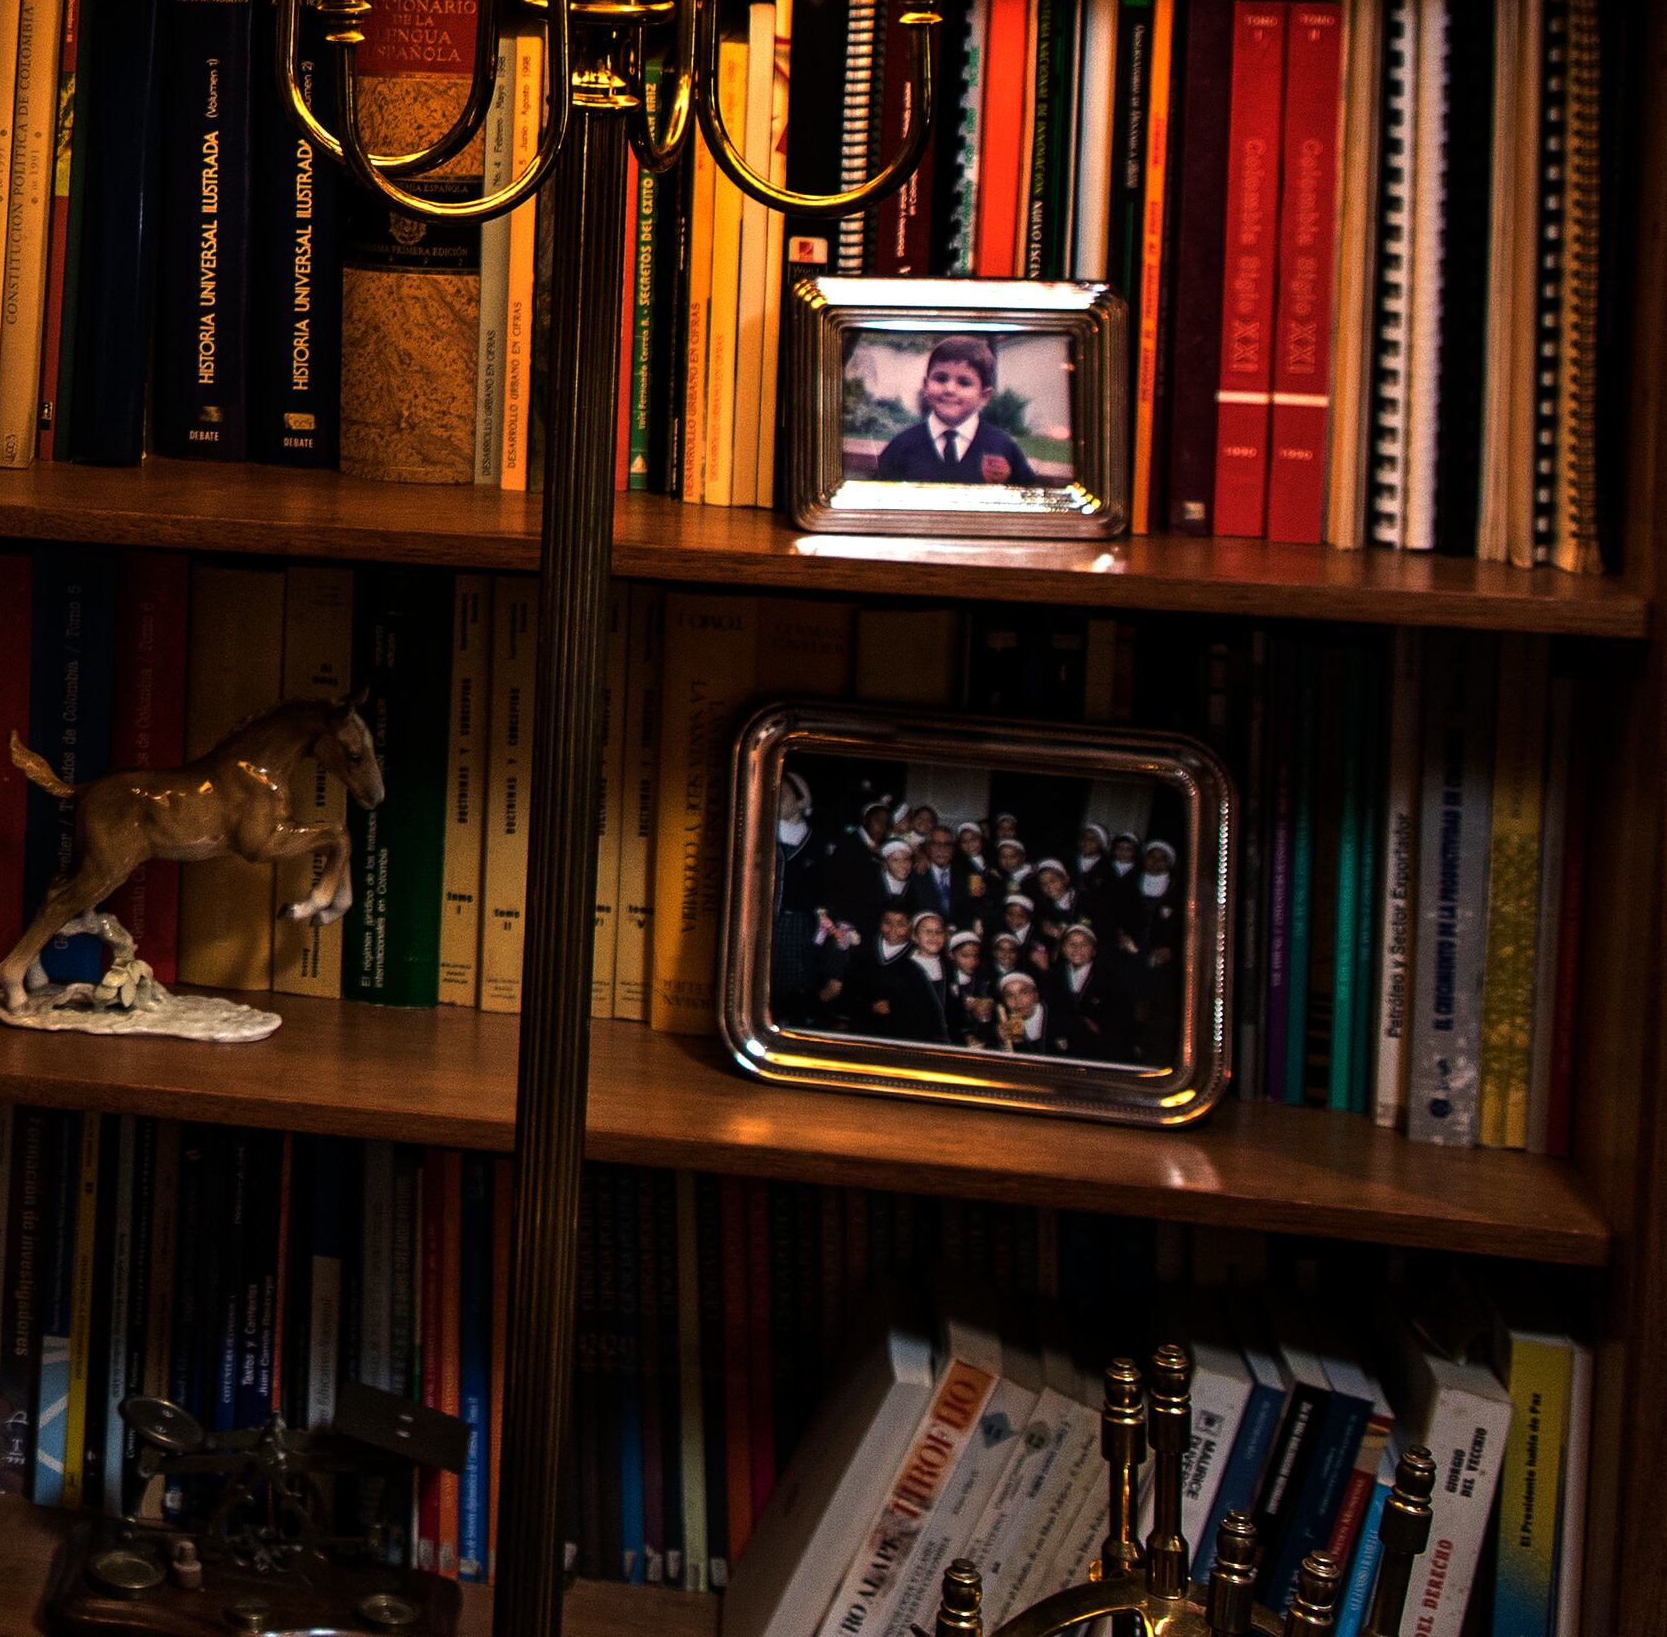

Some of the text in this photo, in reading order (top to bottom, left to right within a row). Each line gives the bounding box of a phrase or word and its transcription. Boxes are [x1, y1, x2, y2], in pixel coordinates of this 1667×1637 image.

[416, 16, 434, 27] LA
[1245, 14, 1279, 26] TOMO
[1299, 14, 1334, 26] TOMO
[205, 69, 220, 119] (Volumen
[200, 130, 219, 213] ILUSTRADA
[200, 220, 218, 306] UNIVERSAL
[1230, 138, 1267, 374] Colombia Siglo XXI
[1286, 138, 1325, 374] Colombia Siglo XXI
[198, 313, 216, 384] HISTORIA
[507, 301, 523, 469] DESARROLLO URBANO EN CIFRAS
[683, 302, 701, 497] DESARROLLO URBANO EN CIFRAS
[188, 430, 219, 441] DEBATE
[283, 438, 314, 448] DEBATE
[507, 688, 520, 746] CONCEPTOS
[504, 777, 517, 834] DOCTRINAS
[360, 811, 377, 987] El régimen jurídico de los tratados
[374, 847, 389, 988] internacionales en Colombia
[1387, 813, 1411, 1038] Petróleo y Sector Exportador
[13, 1116, 45, 1356] Formación de investigadores
[1530, 1420, 1539, 1437] de
[1532, 1392, 1542, 1418] Paz
[1195, 1439, 1217, 1500] MAURICE
[1445, 1448, 1466, 1494] GIORGIO
[1460, 1427, 1487, 1498] DEL VECCHIO
[1522, 1474, 1536, 1533] Presidente
[1520, 1534, 1530, 1547] El
